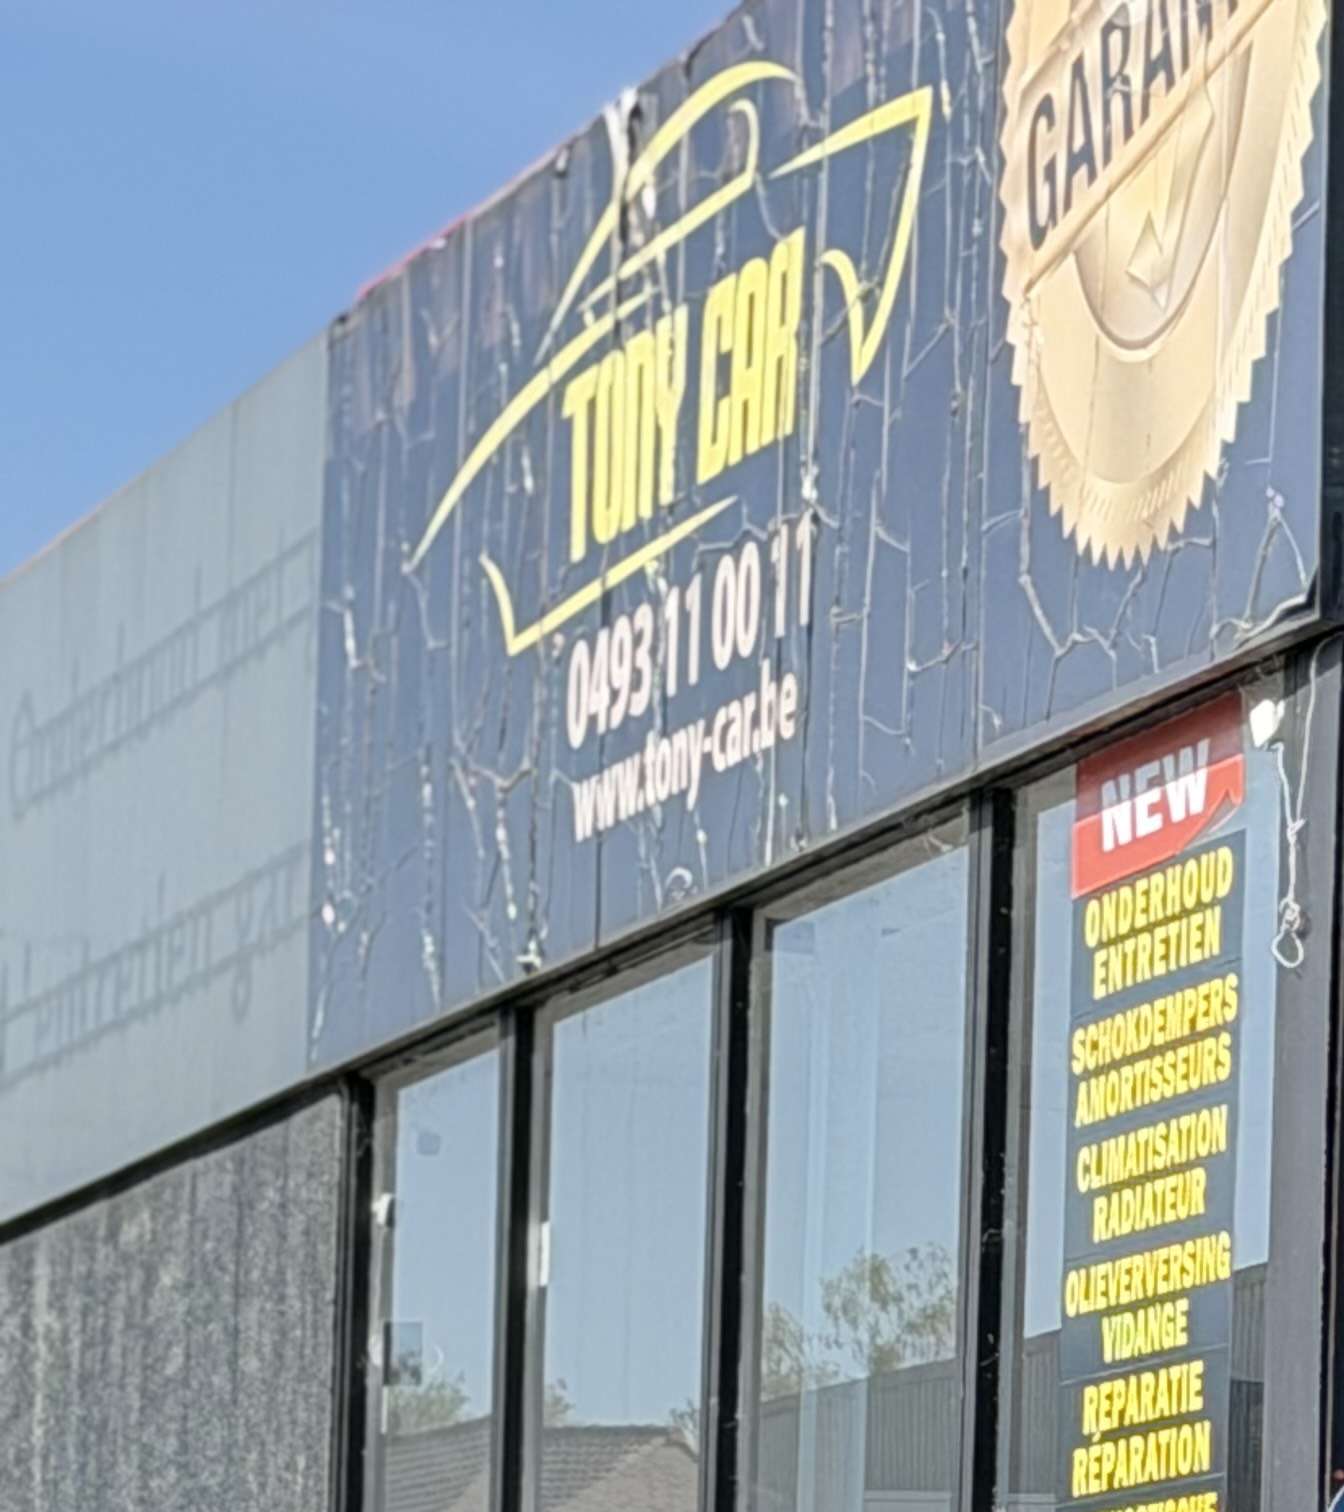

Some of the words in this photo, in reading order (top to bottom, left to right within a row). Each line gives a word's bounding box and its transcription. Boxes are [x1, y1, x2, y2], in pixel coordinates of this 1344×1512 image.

[1027, 0, 1239, 251] GARAN
[562, 304, 688, 563] TONY
[697, 225, 806, 486] CAR
[566, 601, 653, 750] 0493
[664, 572, 702, 698] 11
[711, 540, 762, 671] 00
[771, 506, 812, 639] 11
[571, 658, 797, 843] www.tony-car.be
[1100, 738, 1211, 853] NEW
[1084, 846, 1235, 949] ONDERHOUD
[1093, 904, 1222, 1001] ENTRETIEN
[1071, 972, 1239, 1076] SCHOKDEMPERS
[1074, 1033, 1232, 1129] AMORTISSEURS
[1076, 1104, 1228, 1193] CLIMATISATION
[1092, 1166, 1207, 1244] RADIATEUR
[1064, 1229, 1232, 1318] OLIEVERVERSING
[1102, 1297, 1190, 1364] VIDANGE
[1082, 1359, 1204, 1437] REPARATIE
[1072, 1419, 1212, 1499] RÉPARATION
